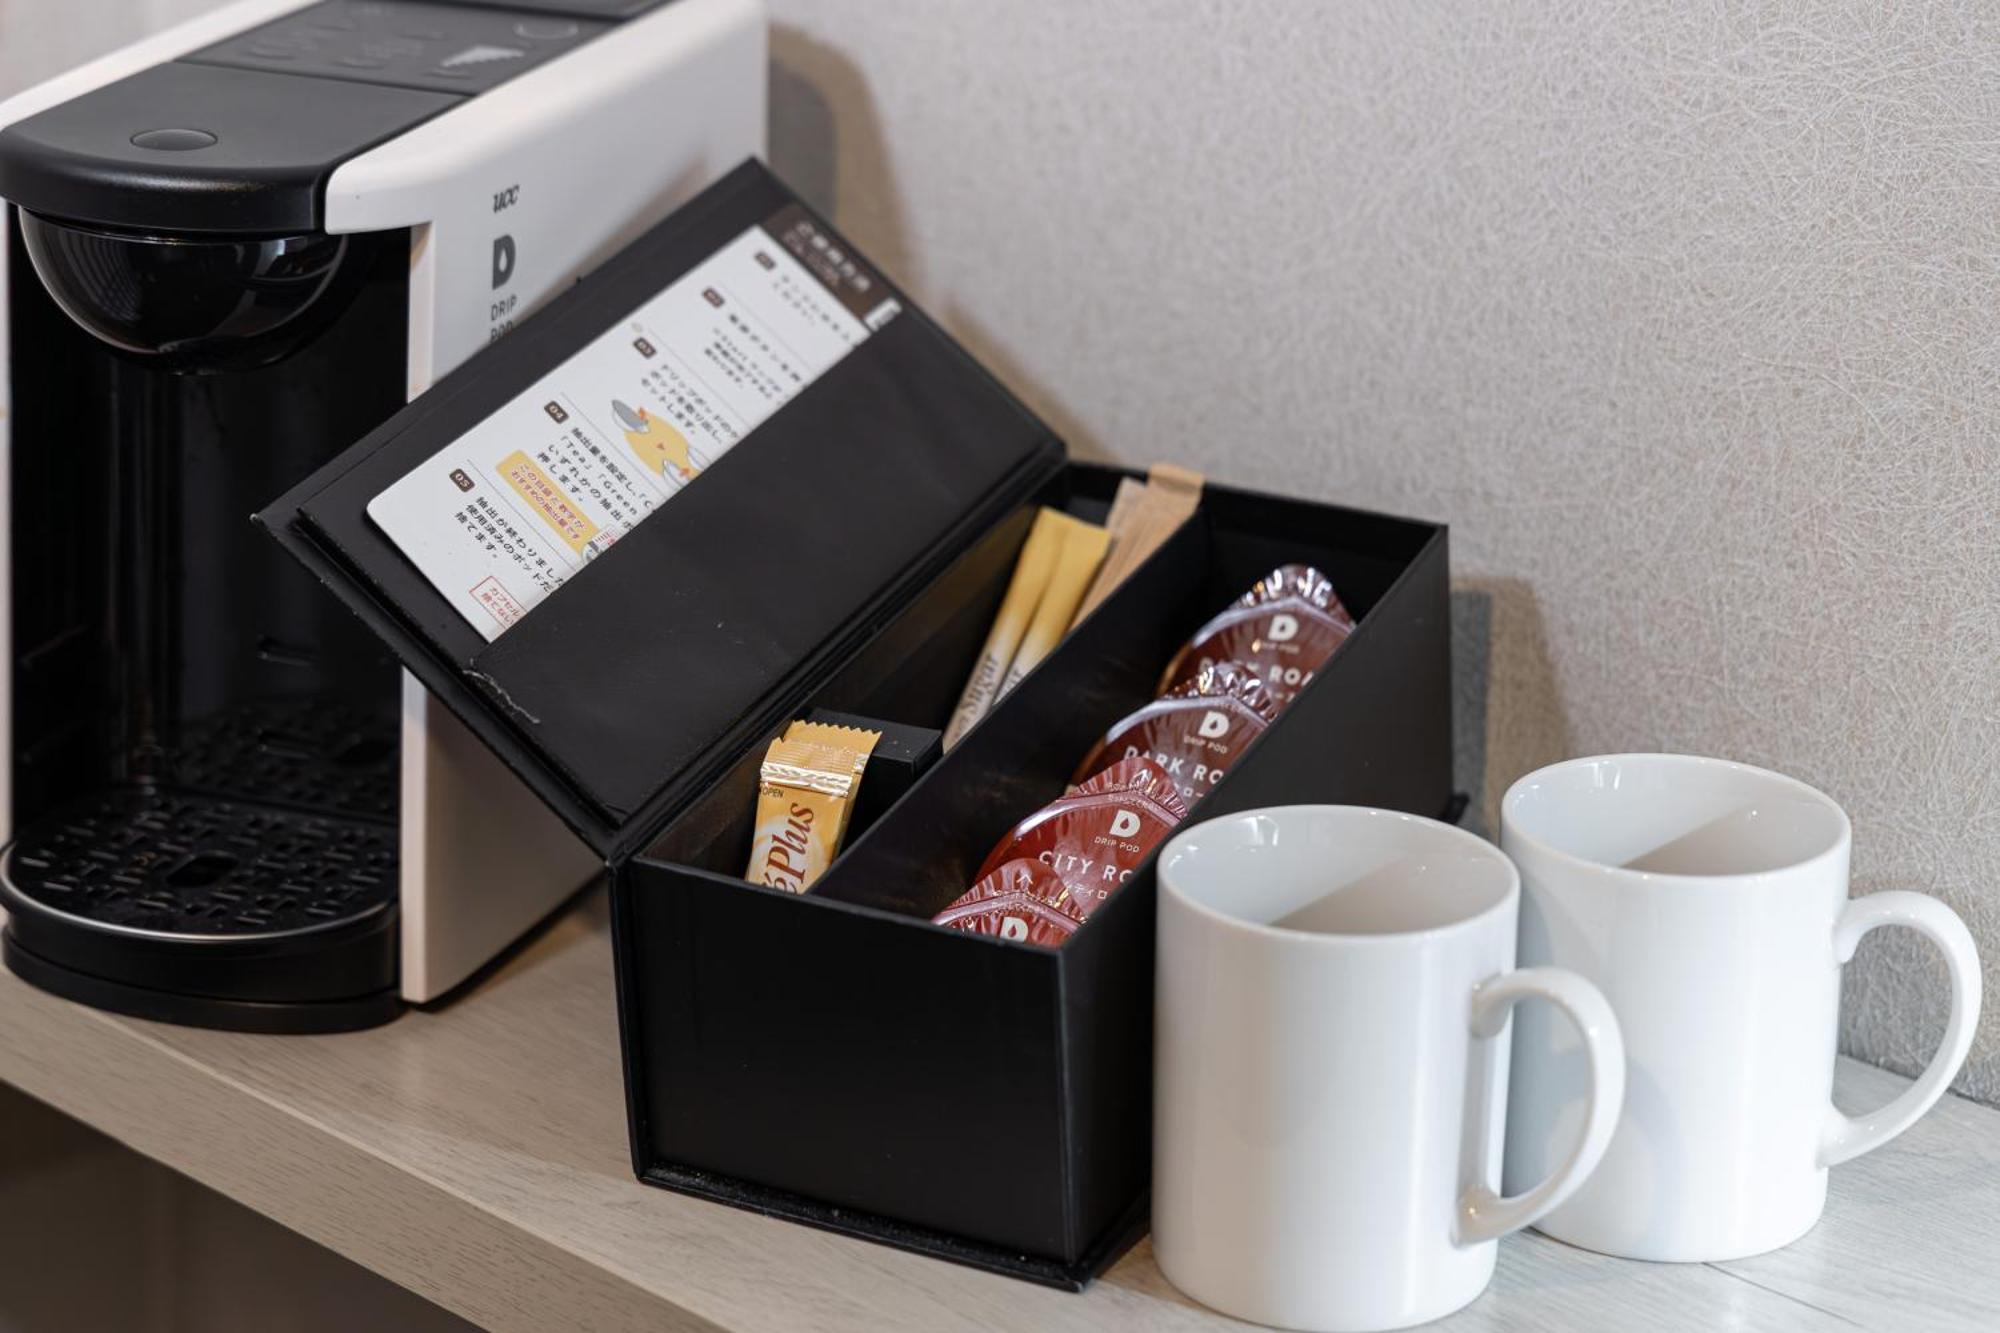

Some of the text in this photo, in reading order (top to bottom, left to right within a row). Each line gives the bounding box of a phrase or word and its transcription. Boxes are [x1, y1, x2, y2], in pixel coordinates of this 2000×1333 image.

[492, 234, 516, 290] D
[490, 294, 517, 321] DRIP
[452, 510, 502, 559] 捨てます。
[463, 503, 557, 596] 使用済みのポッドだ
[1123, 745, 1184, 775] DRK
[1207, 742, 1228, 754] POD
[763, 787, 784, 799] OPEN
[1094, 836, 1140, 853] DRIP POD
[1039, 851, 1093, 875] CITY
